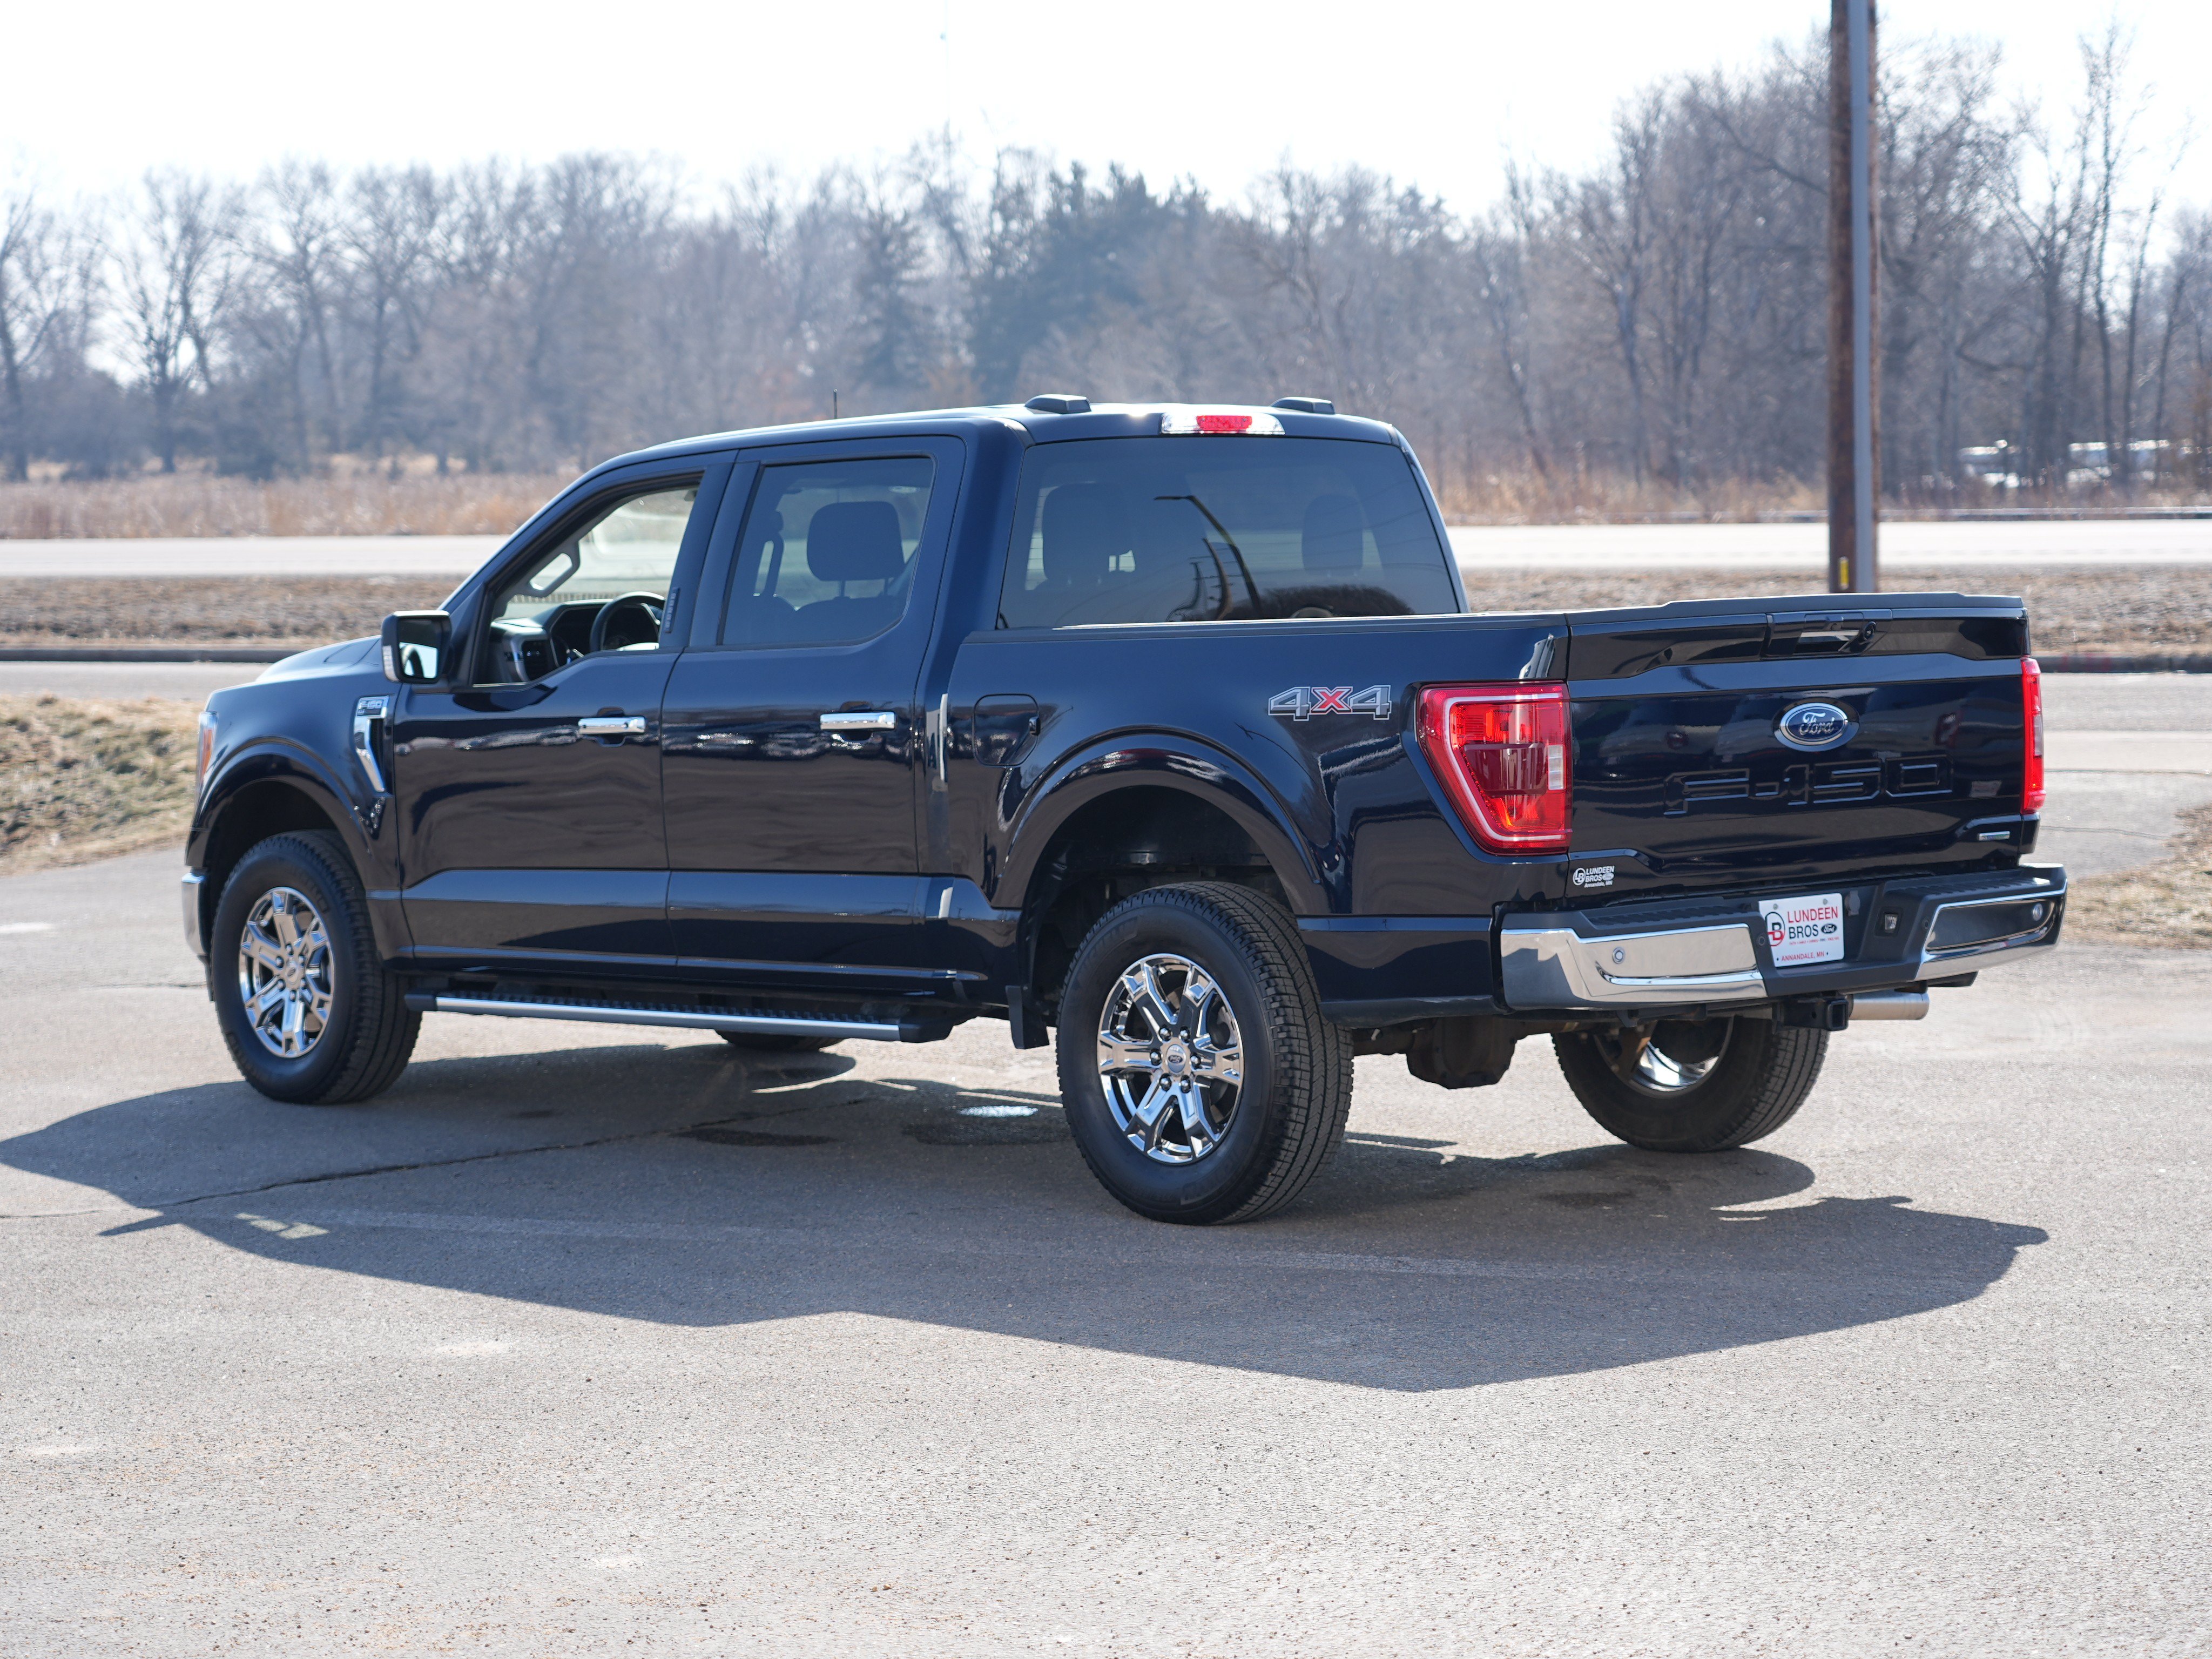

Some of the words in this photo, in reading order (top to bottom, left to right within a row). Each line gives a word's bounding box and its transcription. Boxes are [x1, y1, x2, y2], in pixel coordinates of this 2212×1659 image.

[1799, 711, 1835, 736] Ford
[1663, 754, 1953, 815] F-150
[1586, 866, 1614, 875] LUNDEEN
[1585, 874, 1602, 882] BROS
[1788, 906, 1838, 923] LUNDEEN
[1789, 924, 1819, 940] BROS
[1822, 924, 1836, 933] Ford
[1781, 952, 1815, 961] ANNANDALE,
